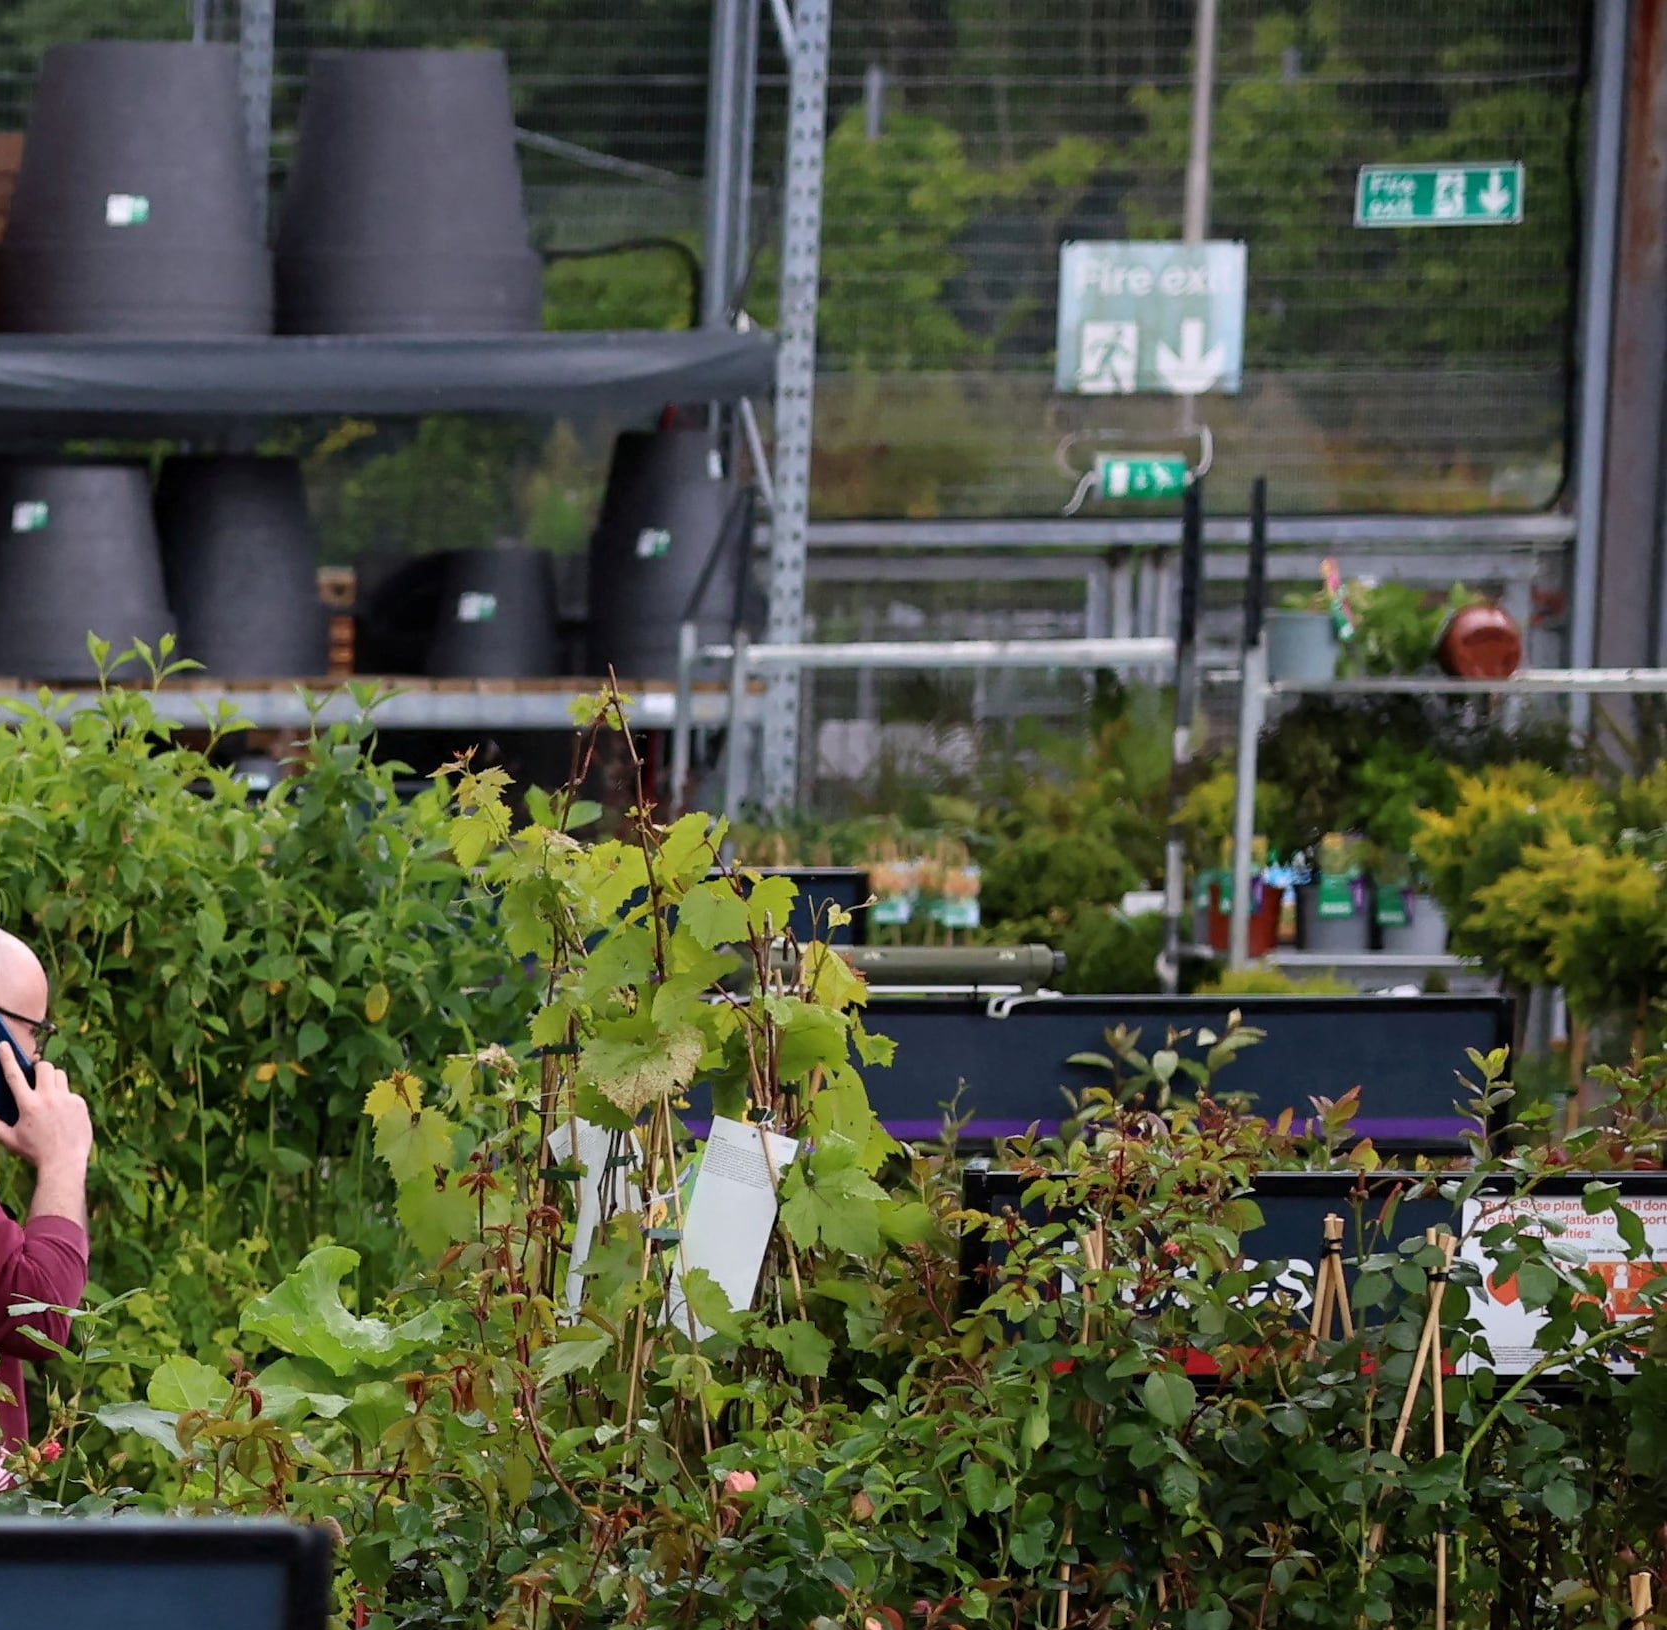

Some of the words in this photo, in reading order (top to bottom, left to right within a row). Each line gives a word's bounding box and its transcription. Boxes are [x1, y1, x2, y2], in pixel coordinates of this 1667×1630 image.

[1369, 172, 1415, 193] Fire
[1076, 258, 1153, 297] Fire
[1602, 1215, 1614, 1225] to
